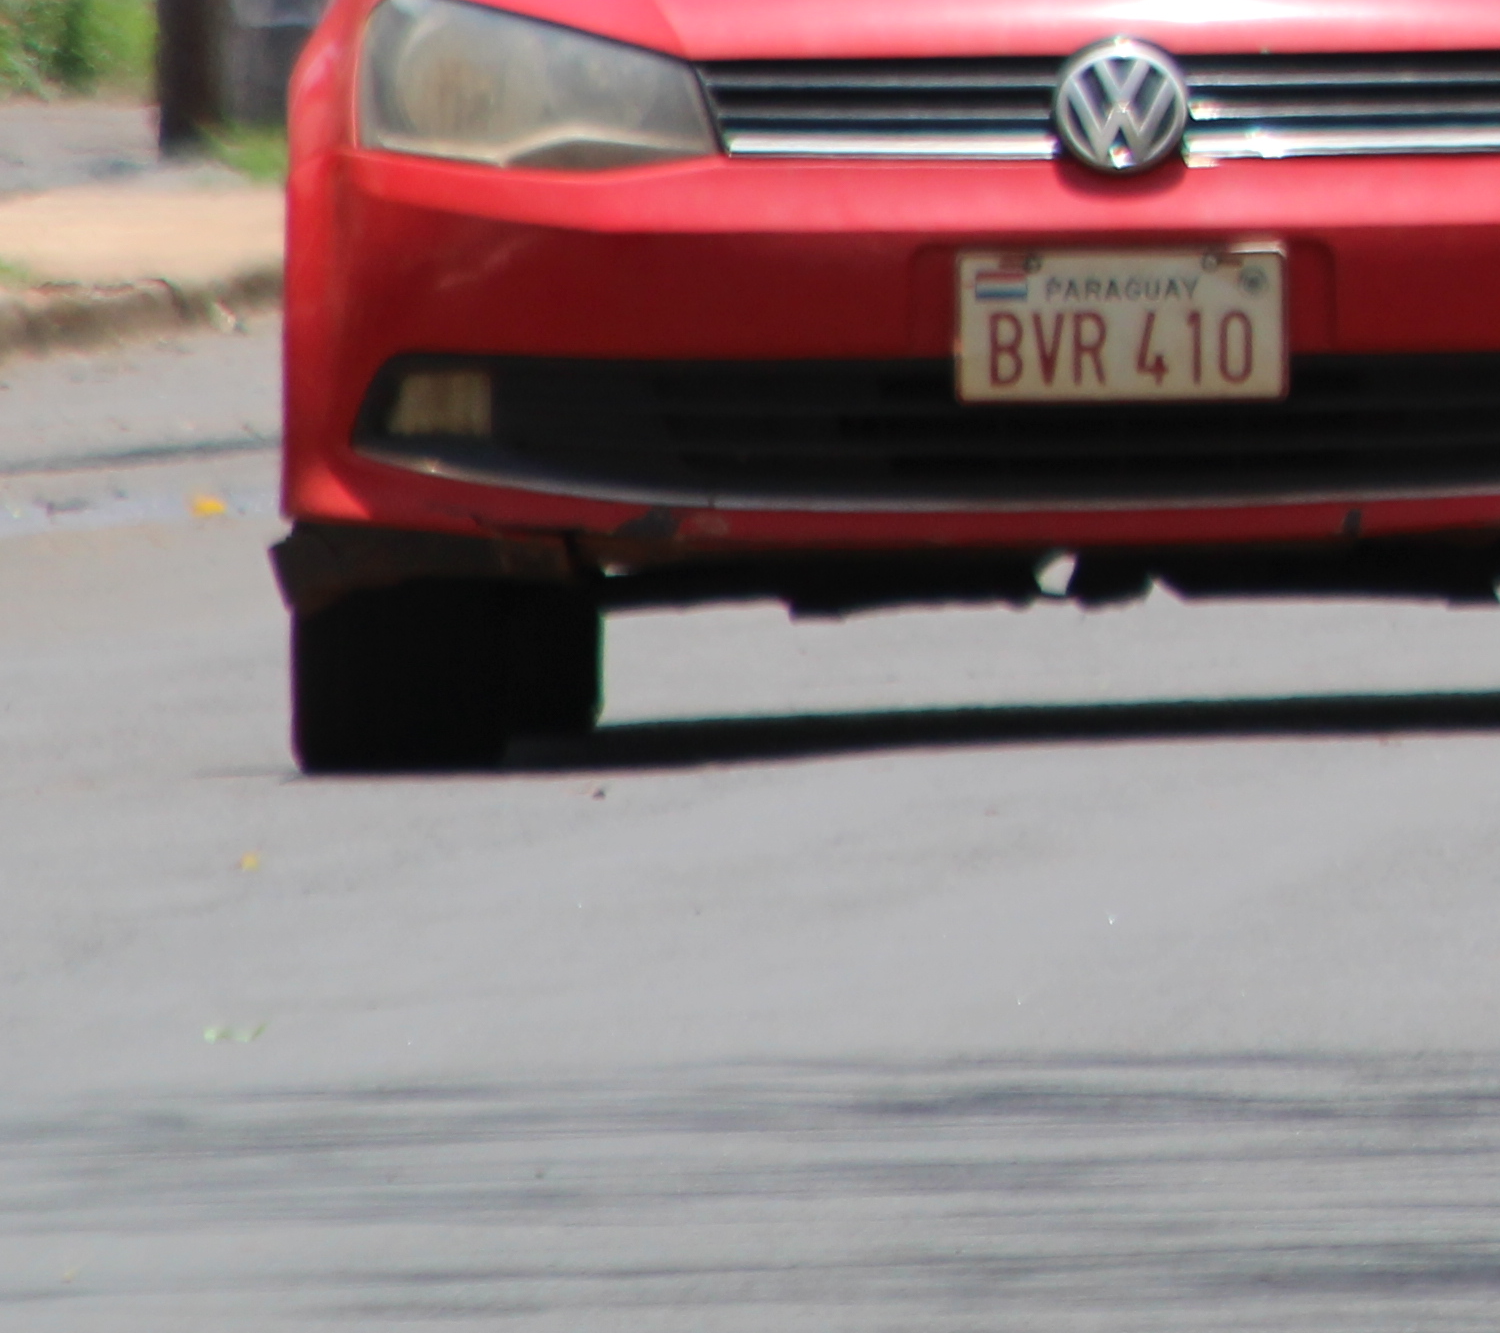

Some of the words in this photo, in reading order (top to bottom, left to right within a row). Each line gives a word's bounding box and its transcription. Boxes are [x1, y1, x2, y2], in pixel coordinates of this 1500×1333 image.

[1044, 275, 1199, 302] PARAGUAY
[988, 309, 1107, 388] BVR
[1134, 307, 1254, 388] 410
